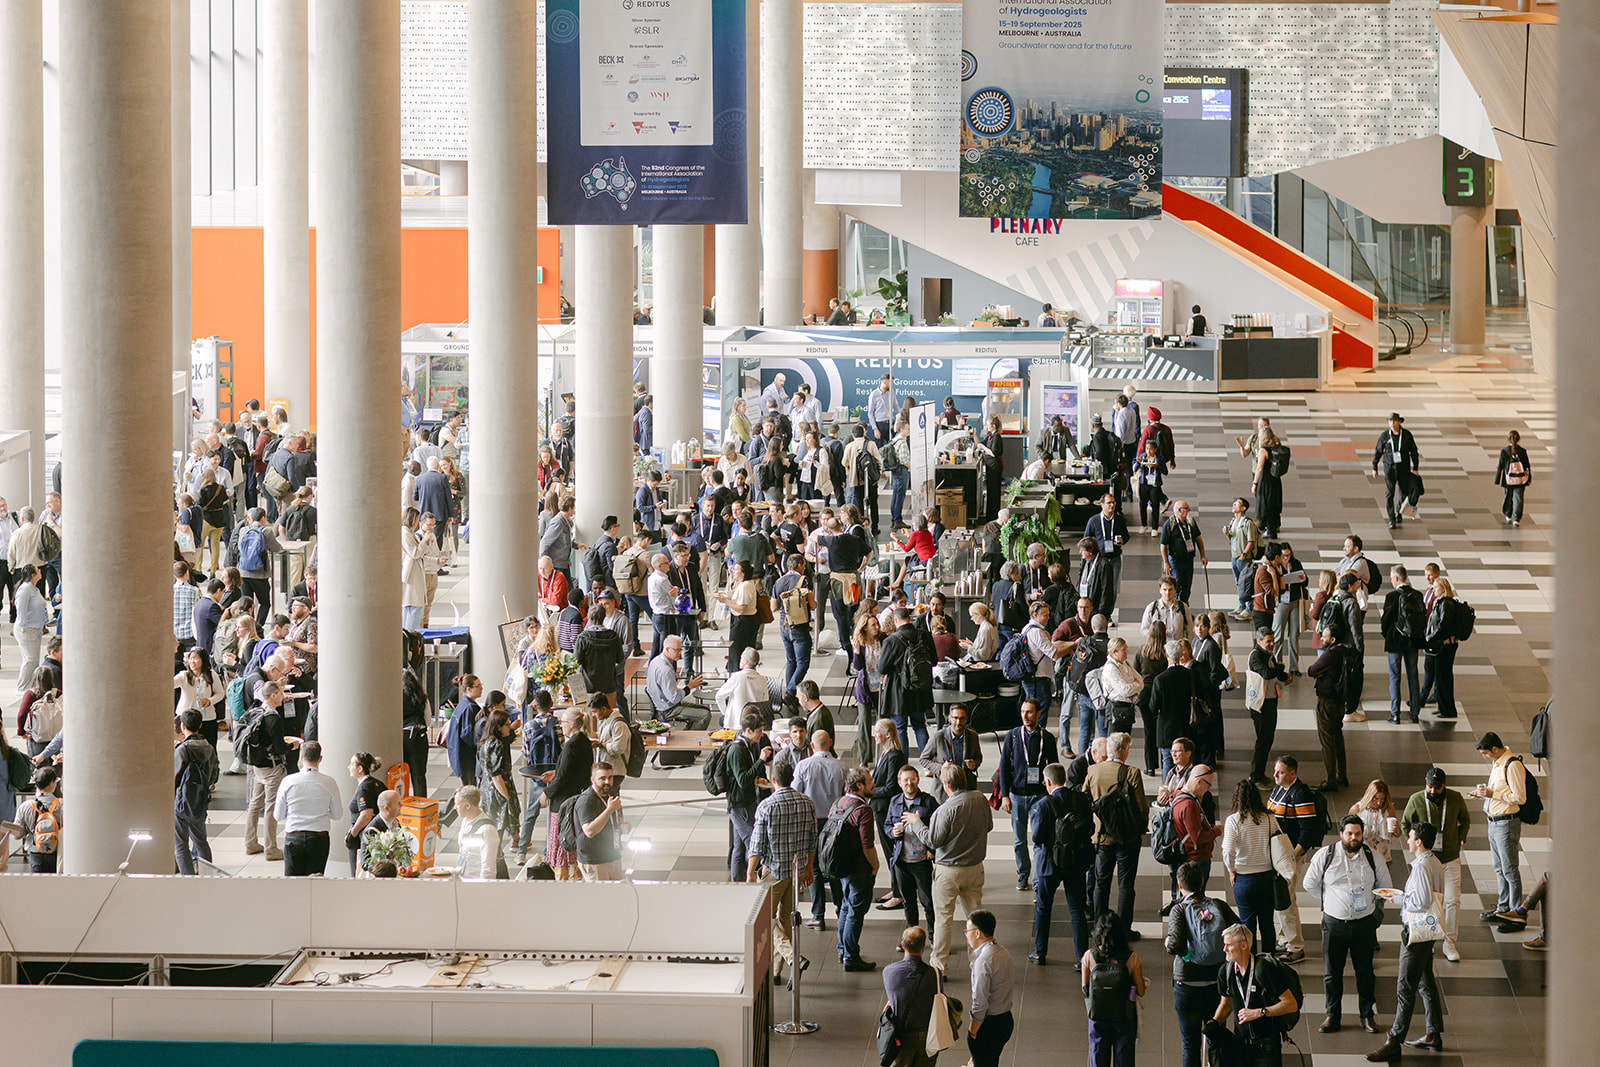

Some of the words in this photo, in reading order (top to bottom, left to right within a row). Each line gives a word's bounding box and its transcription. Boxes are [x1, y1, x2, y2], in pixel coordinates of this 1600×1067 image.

[1010, 7, 1087, 17] Hydrogeologists
[599, 56, 615, 64] BECK
[1163, 75, 1202, 84] Convention
[1203, 75, 1226, 84] Centre
[651, 92, 669, 101] wsp
[1457, 167, 1474, 197] 3
[1488, 167, 1493, 196] 3
[990, 218, 1063, 234] PLENARY
[1016, 237, 1039, 246] CAFE
[856, 359, 943, 369] REDITUS
